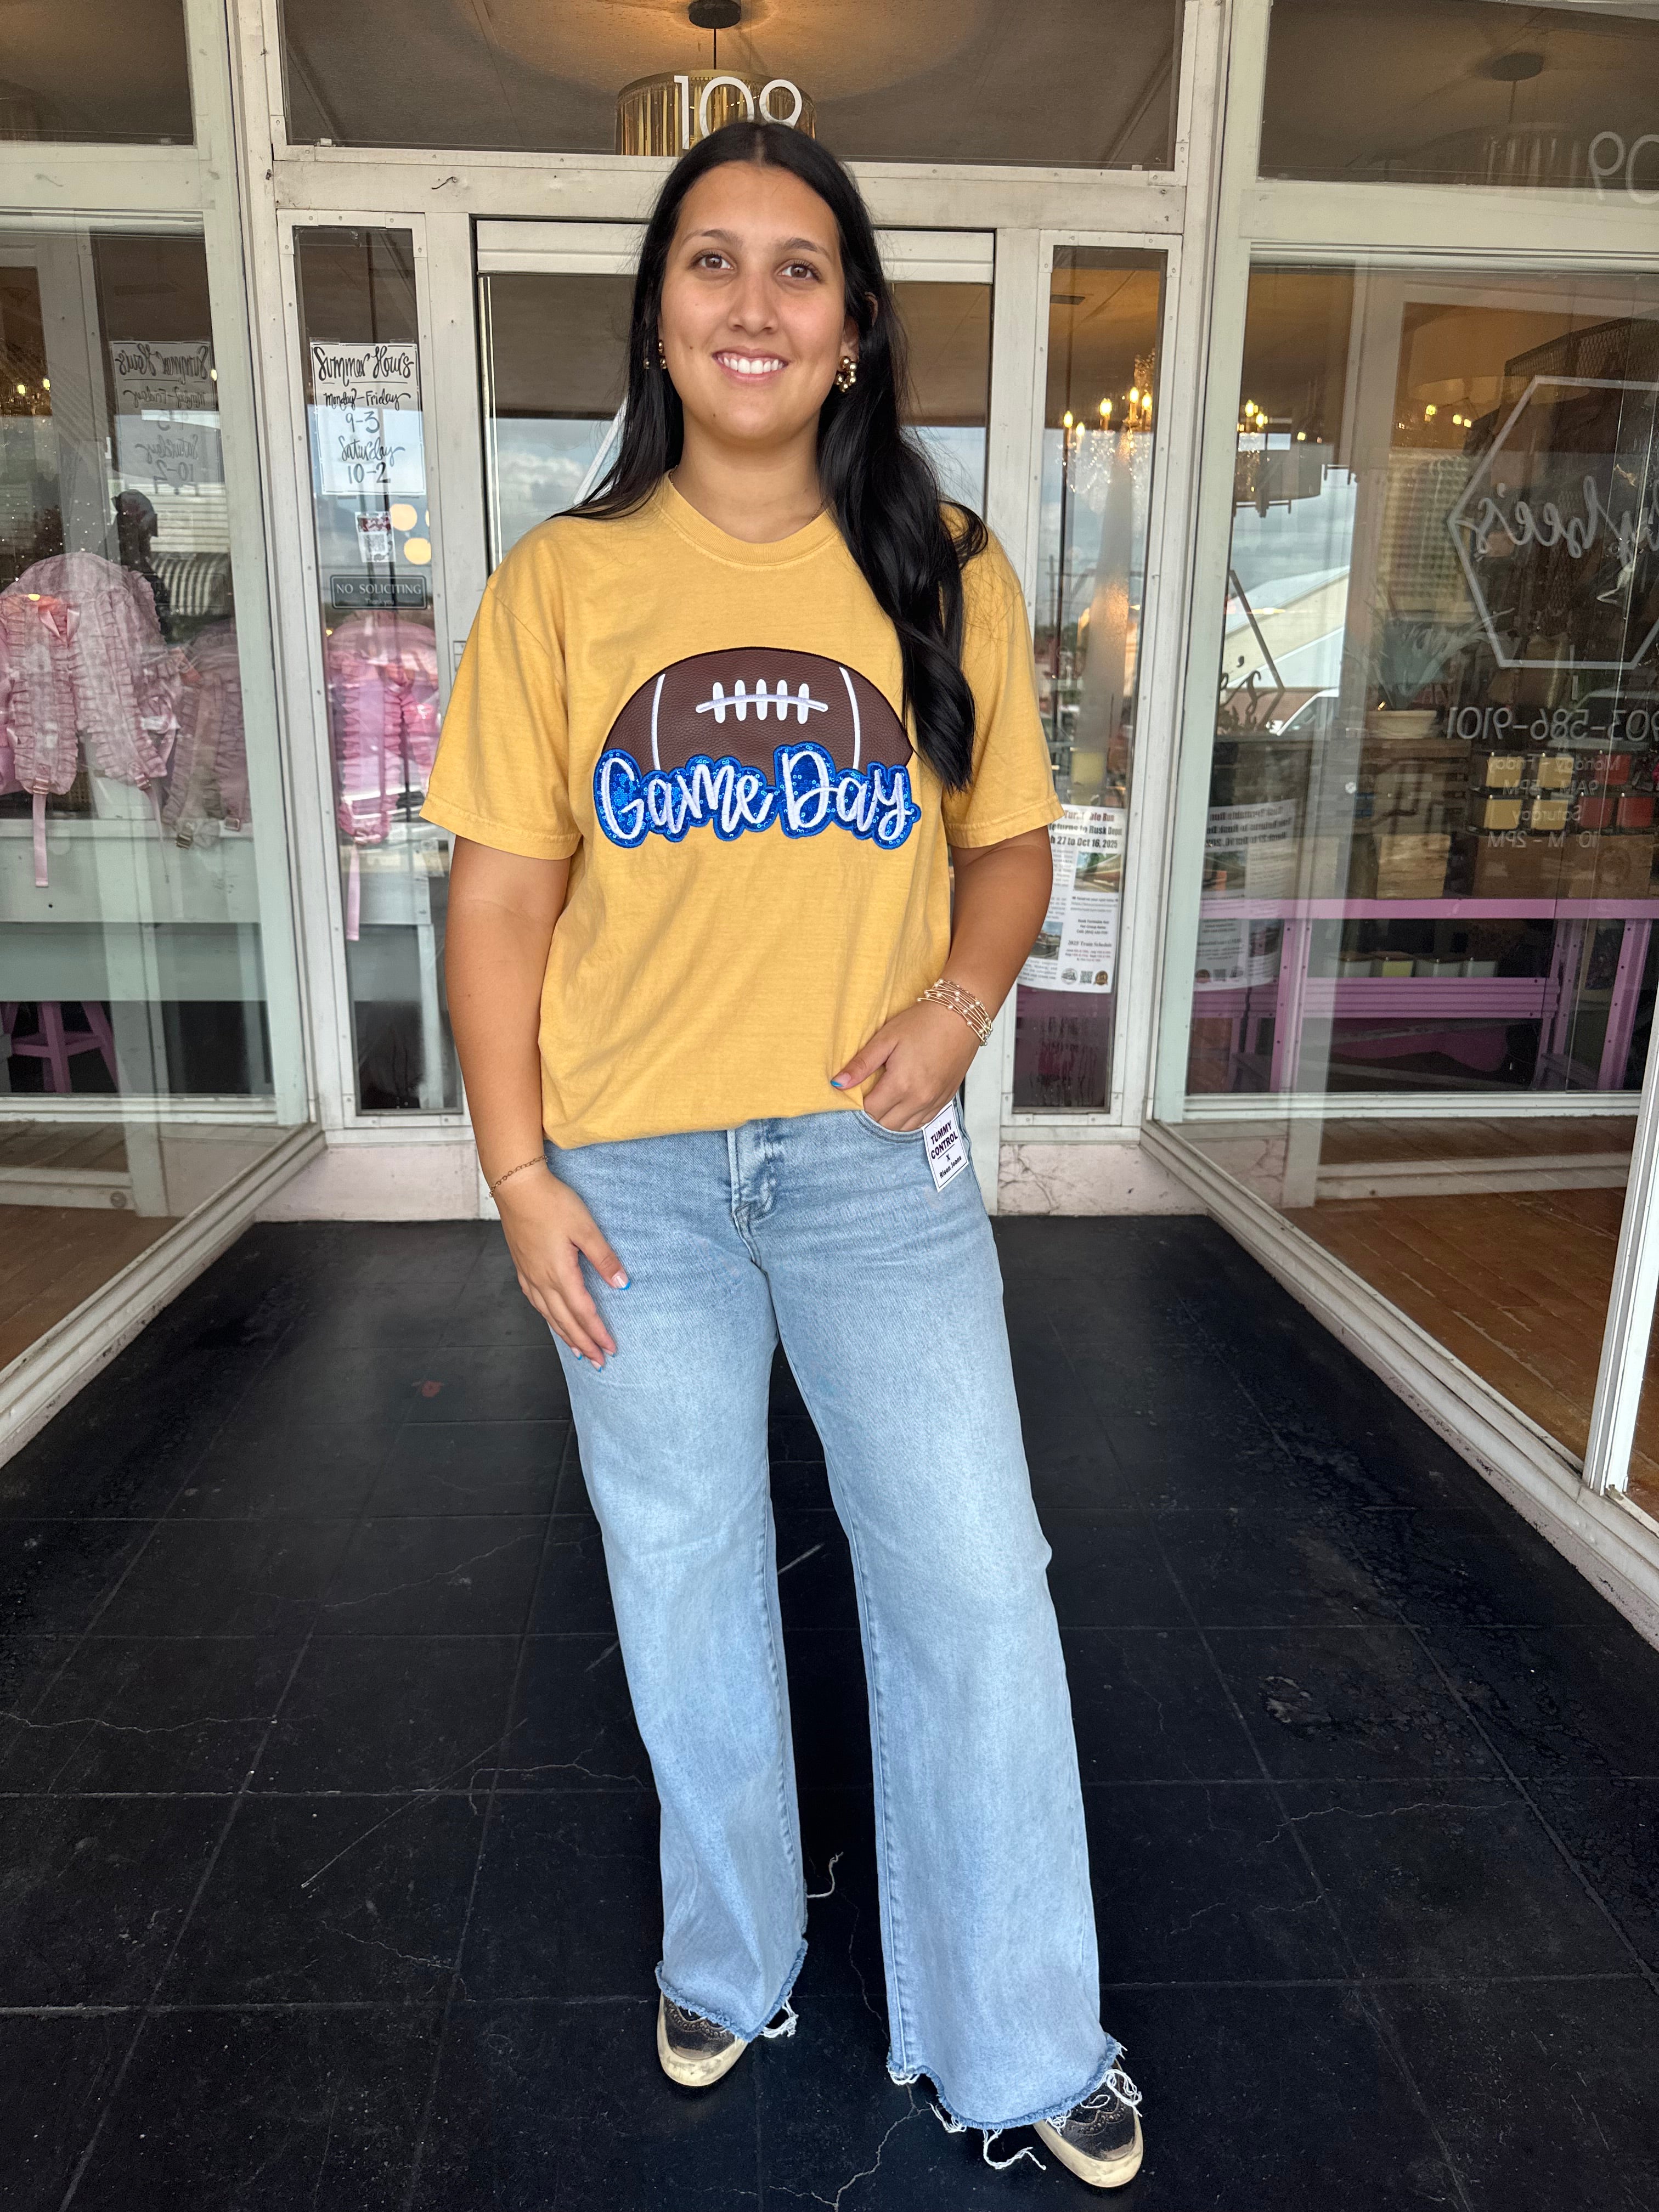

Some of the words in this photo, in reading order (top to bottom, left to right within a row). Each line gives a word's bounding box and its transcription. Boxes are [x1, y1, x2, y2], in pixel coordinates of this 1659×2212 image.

[314, 346, 370, 386] Summer
[373, 346, 414, 379] Hours
[346, 411, 380, 433] 9-3
[338, 436, 405, 466] Saturday
[348, 462, 391, 484] 10-2
[336, 584, 353, 594] NO
[359, 584, 421, 595] SOLICITING
[600, 756, 775, 840] Game
[781, 750, 913, 842] Day
[1089, 825, 1107, 834] Rusk
[1057, 836, 1066, 845] 27
[1068, 837, 1075, 845] to
[1077, 837, 1090, 847] Oct
[1102, 839, 1118, 849] 2025
[931, 1121, 951, 1144] TUMMY
[931, 1131, 958, 1159] CONTROL
[940, 1166, 951, 1178] Risen
